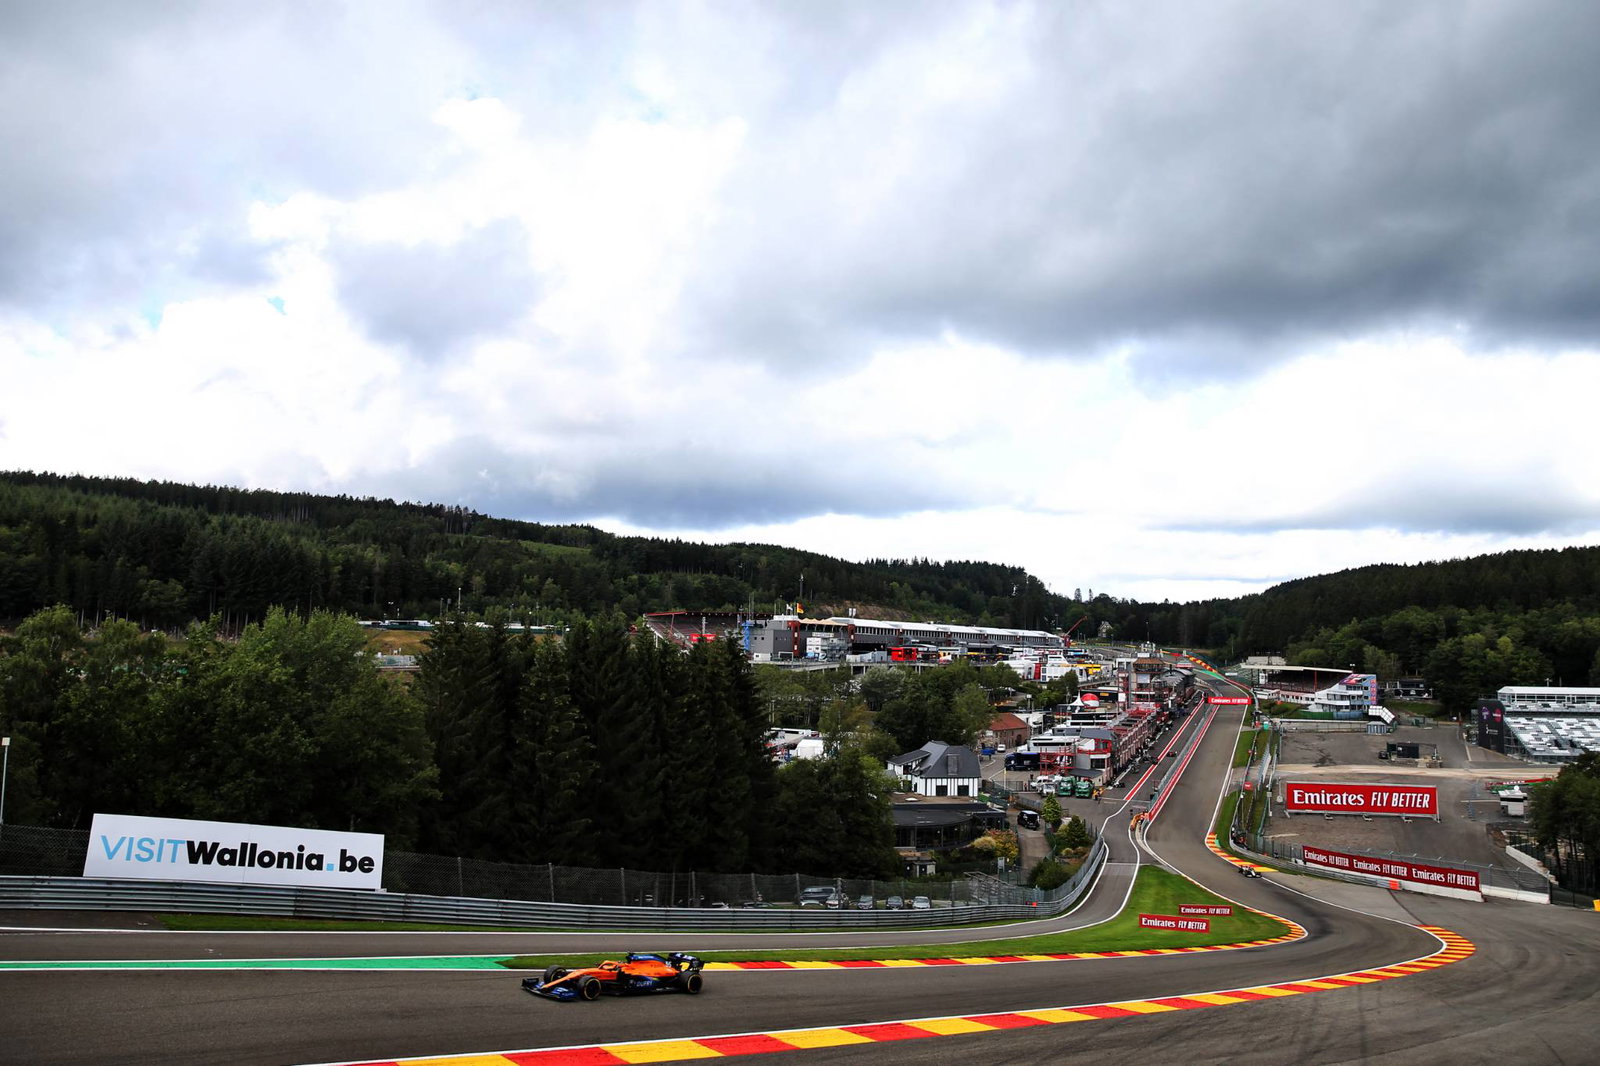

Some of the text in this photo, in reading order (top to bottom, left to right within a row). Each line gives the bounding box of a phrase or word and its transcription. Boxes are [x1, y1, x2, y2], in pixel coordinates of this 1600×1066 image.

[1293, 790, 1430, 808] Emirates FLY BETTER
[1304, 849, 1327, 863] Emirates
[1336, 856, 1350, 867] BETTER
[1353, 860, 1380, 872] Emirates
[1391, 865, 1408, 876] BETTER
[1412, 868, 1445, 882] Emirates
[1447, 872, 1456, 884] FLY
[1456, 874, 1476, 886] BETTER
[1142, 918, 1206, 930] Emirates FLY BETTER
